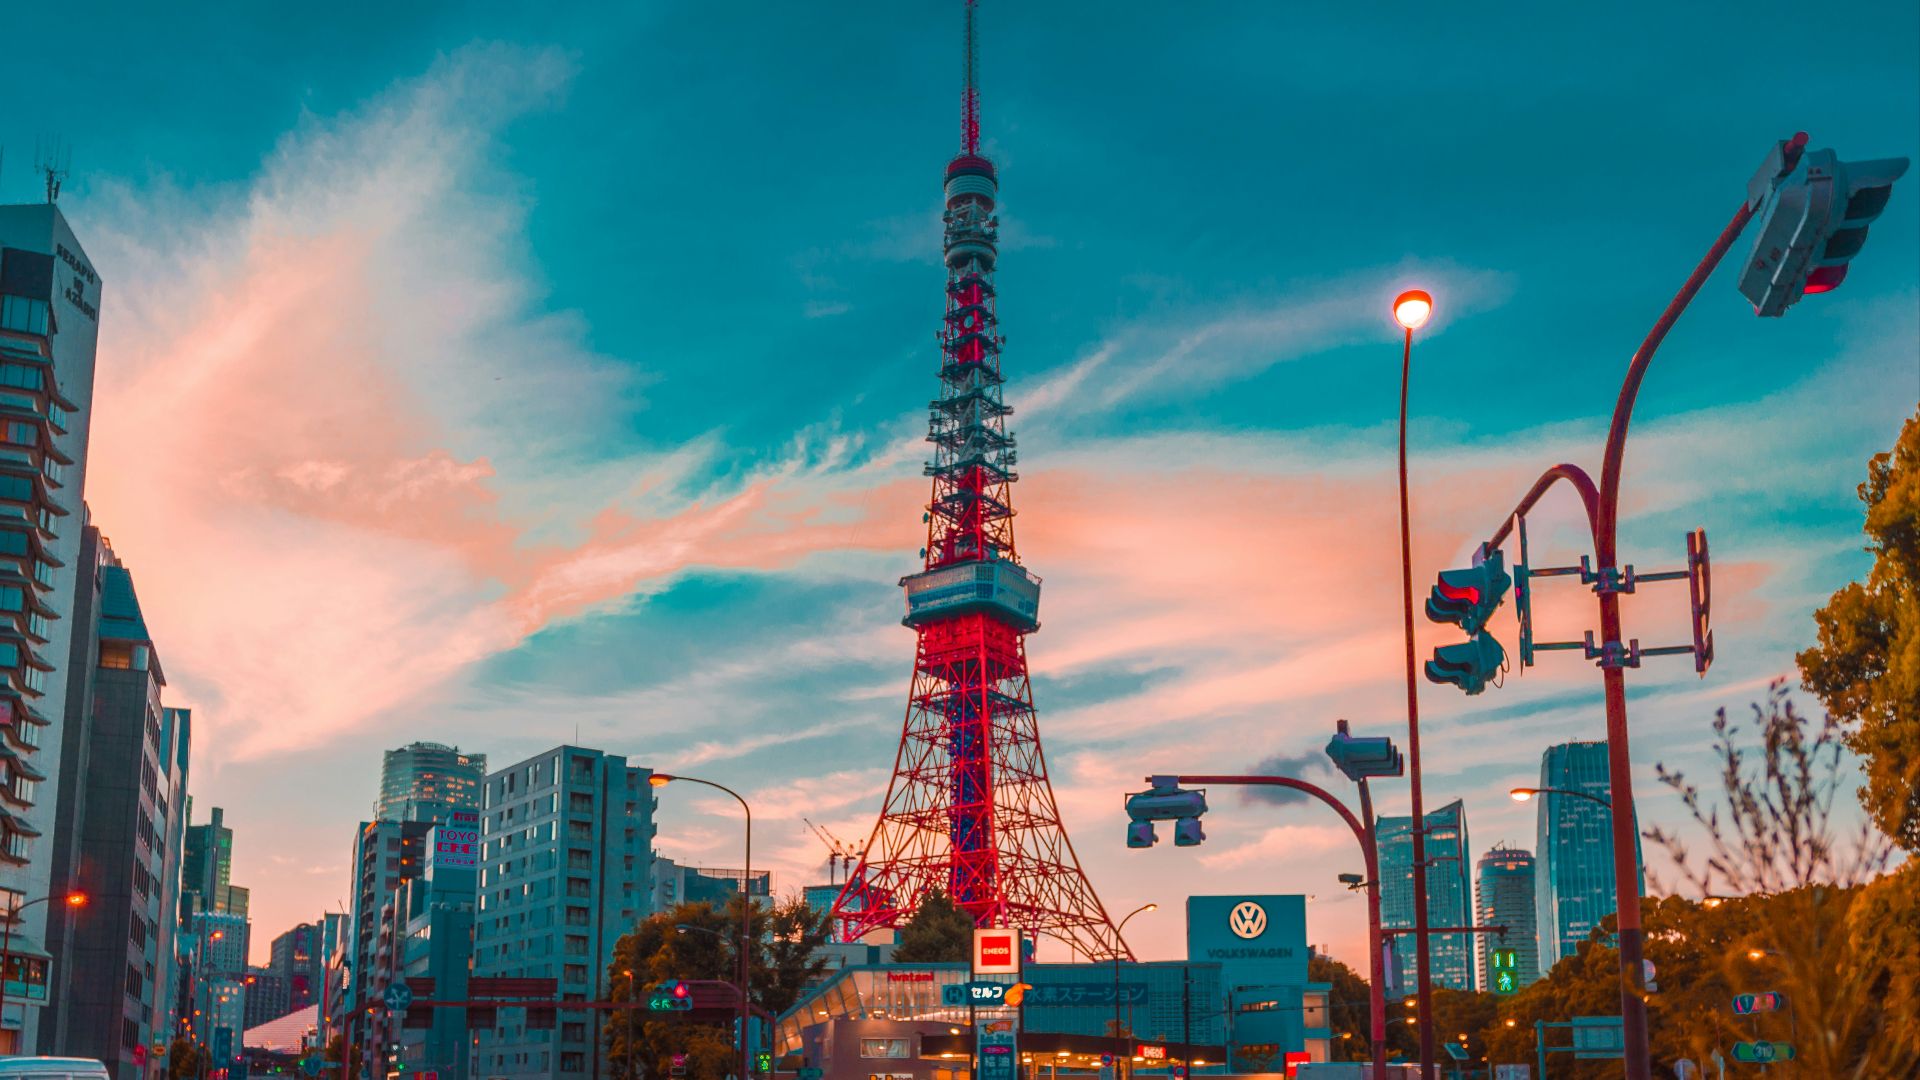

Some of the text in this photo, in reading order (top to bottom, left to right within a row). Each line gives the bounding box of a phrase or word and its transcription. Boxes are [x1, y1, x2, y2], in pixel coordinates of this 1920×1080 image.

[983, 947, 1009, 955] ENEOS
[1207, 948, 1293, 959] VOLKSWAGEN
[971, 986, 1003, 999] セルフ
[1026, 985, 1145, 1003] 水素ステーション
